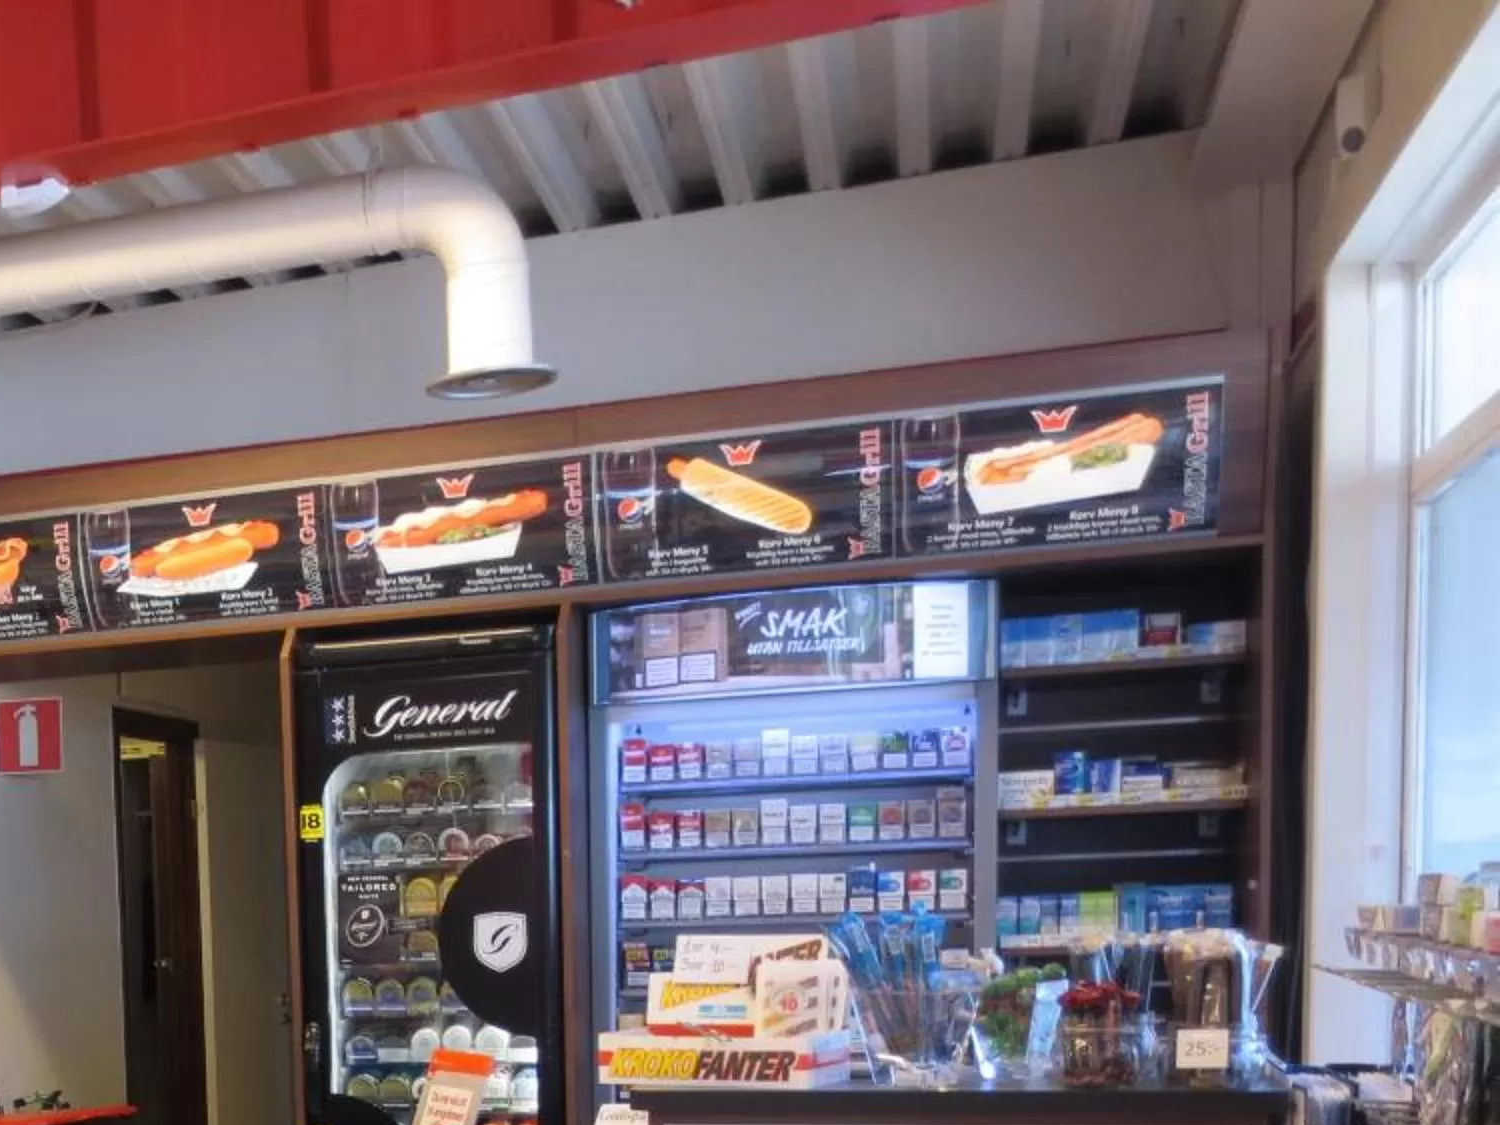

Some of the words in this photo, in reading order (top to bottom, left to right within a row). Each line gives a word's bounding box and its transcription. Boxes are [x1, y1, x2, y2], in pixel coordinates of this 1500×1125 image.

[759, 607, 849, 638] SMAK
[746, 640, 784, 656] UTAN
[363, 688, 519, 738] General
[301, 813, 322, 830] 18
[340, 883, 397, 893] TAILORED
[1185, 1039, 1221, 1057] 25:-
[610, 1047, 798, 1084] KROKOFANTER
